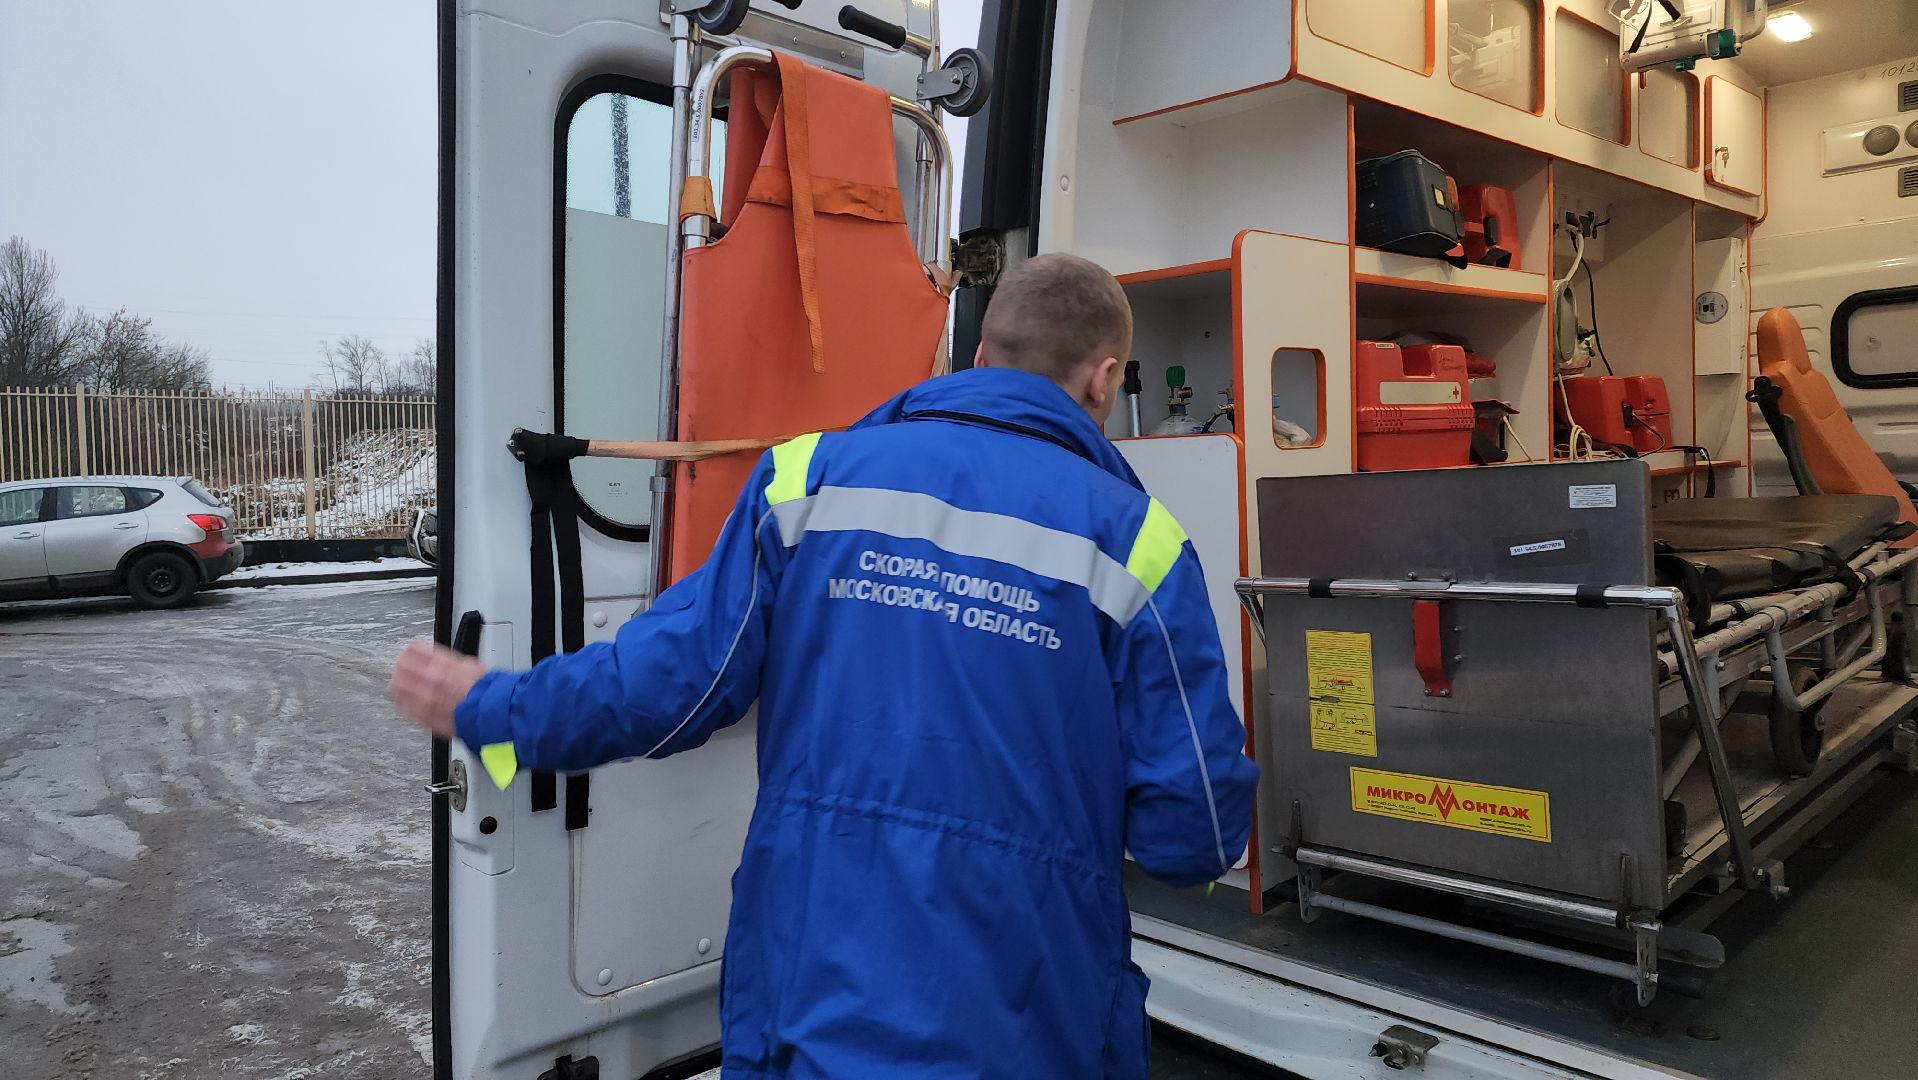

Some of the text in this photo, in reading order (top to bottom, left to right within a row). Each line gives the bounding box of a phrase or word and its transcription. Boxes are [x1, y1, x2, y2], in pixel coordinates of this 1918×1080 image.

[829, 579, 1062, 650] МОСКОВСКАЯ ОБЛАСТЬ
[859, 550, 1040, 613] СКОРАЯ ПОМОЩЬ
